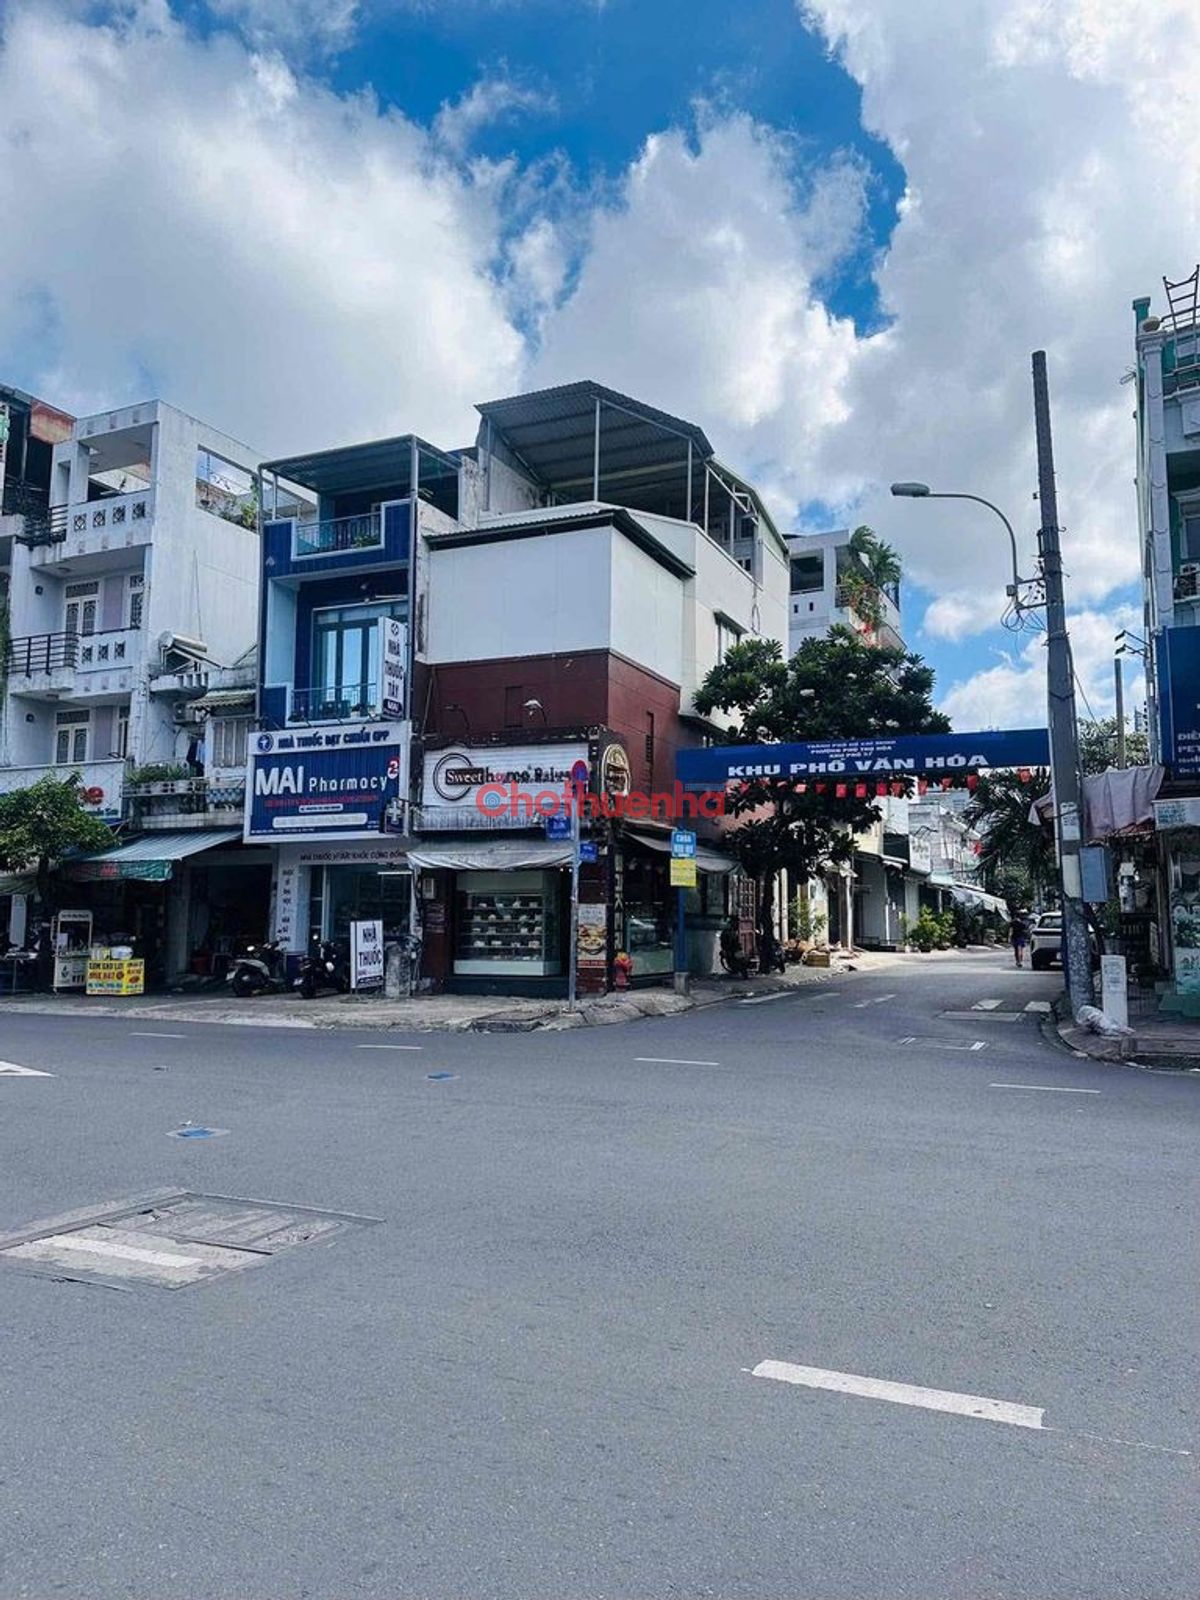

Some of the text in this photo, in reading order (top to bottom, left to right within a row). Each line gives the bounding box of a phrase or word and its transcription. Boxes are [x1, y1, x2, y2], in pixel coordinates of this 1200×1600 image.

[728, 754, 989, 776] KHU PHỐ VĂN HÓA
[255, 765, 304, 796] MAI
[309, 776, 388, 792] Pharmacy
[446, 770, 483, 784] Sweet
